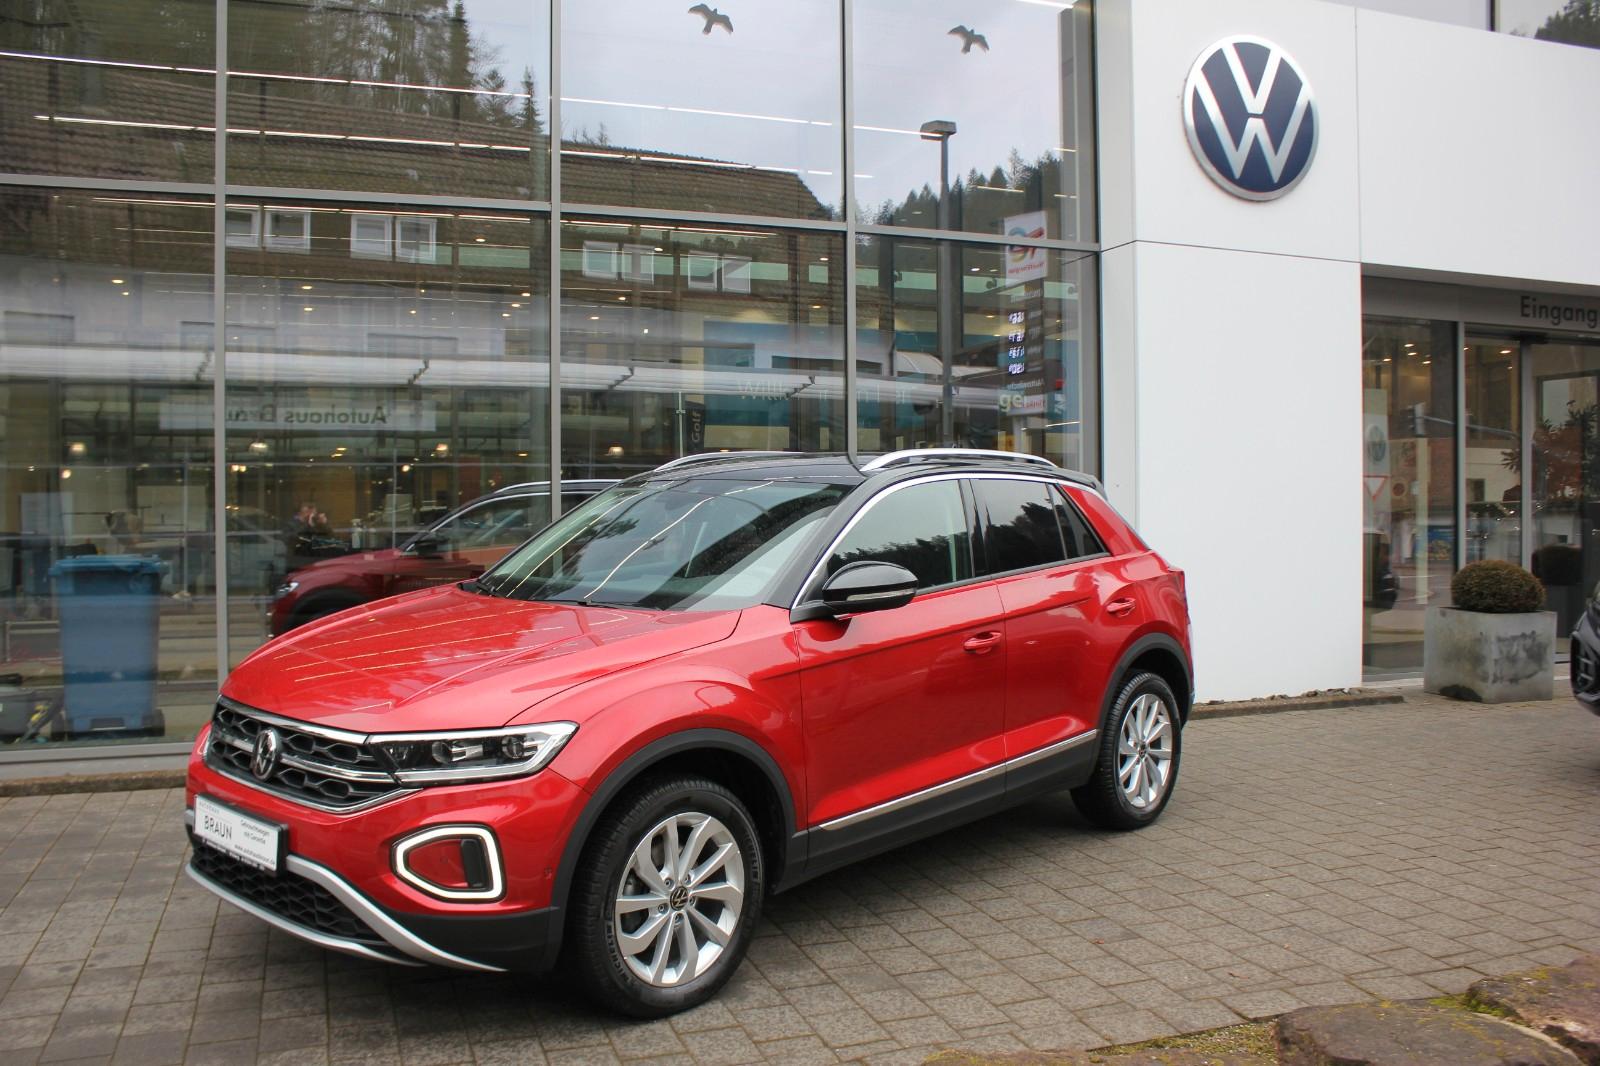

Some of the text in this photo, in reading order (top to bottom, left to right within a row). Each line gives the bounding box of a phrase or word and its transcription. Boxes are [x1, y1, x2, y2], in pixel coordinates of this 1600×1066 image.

[1184, 34, 1319, 202] VW
[1520, 295, 1598, 329] Eingang
[204, 815, 233, 840] BRAUN
